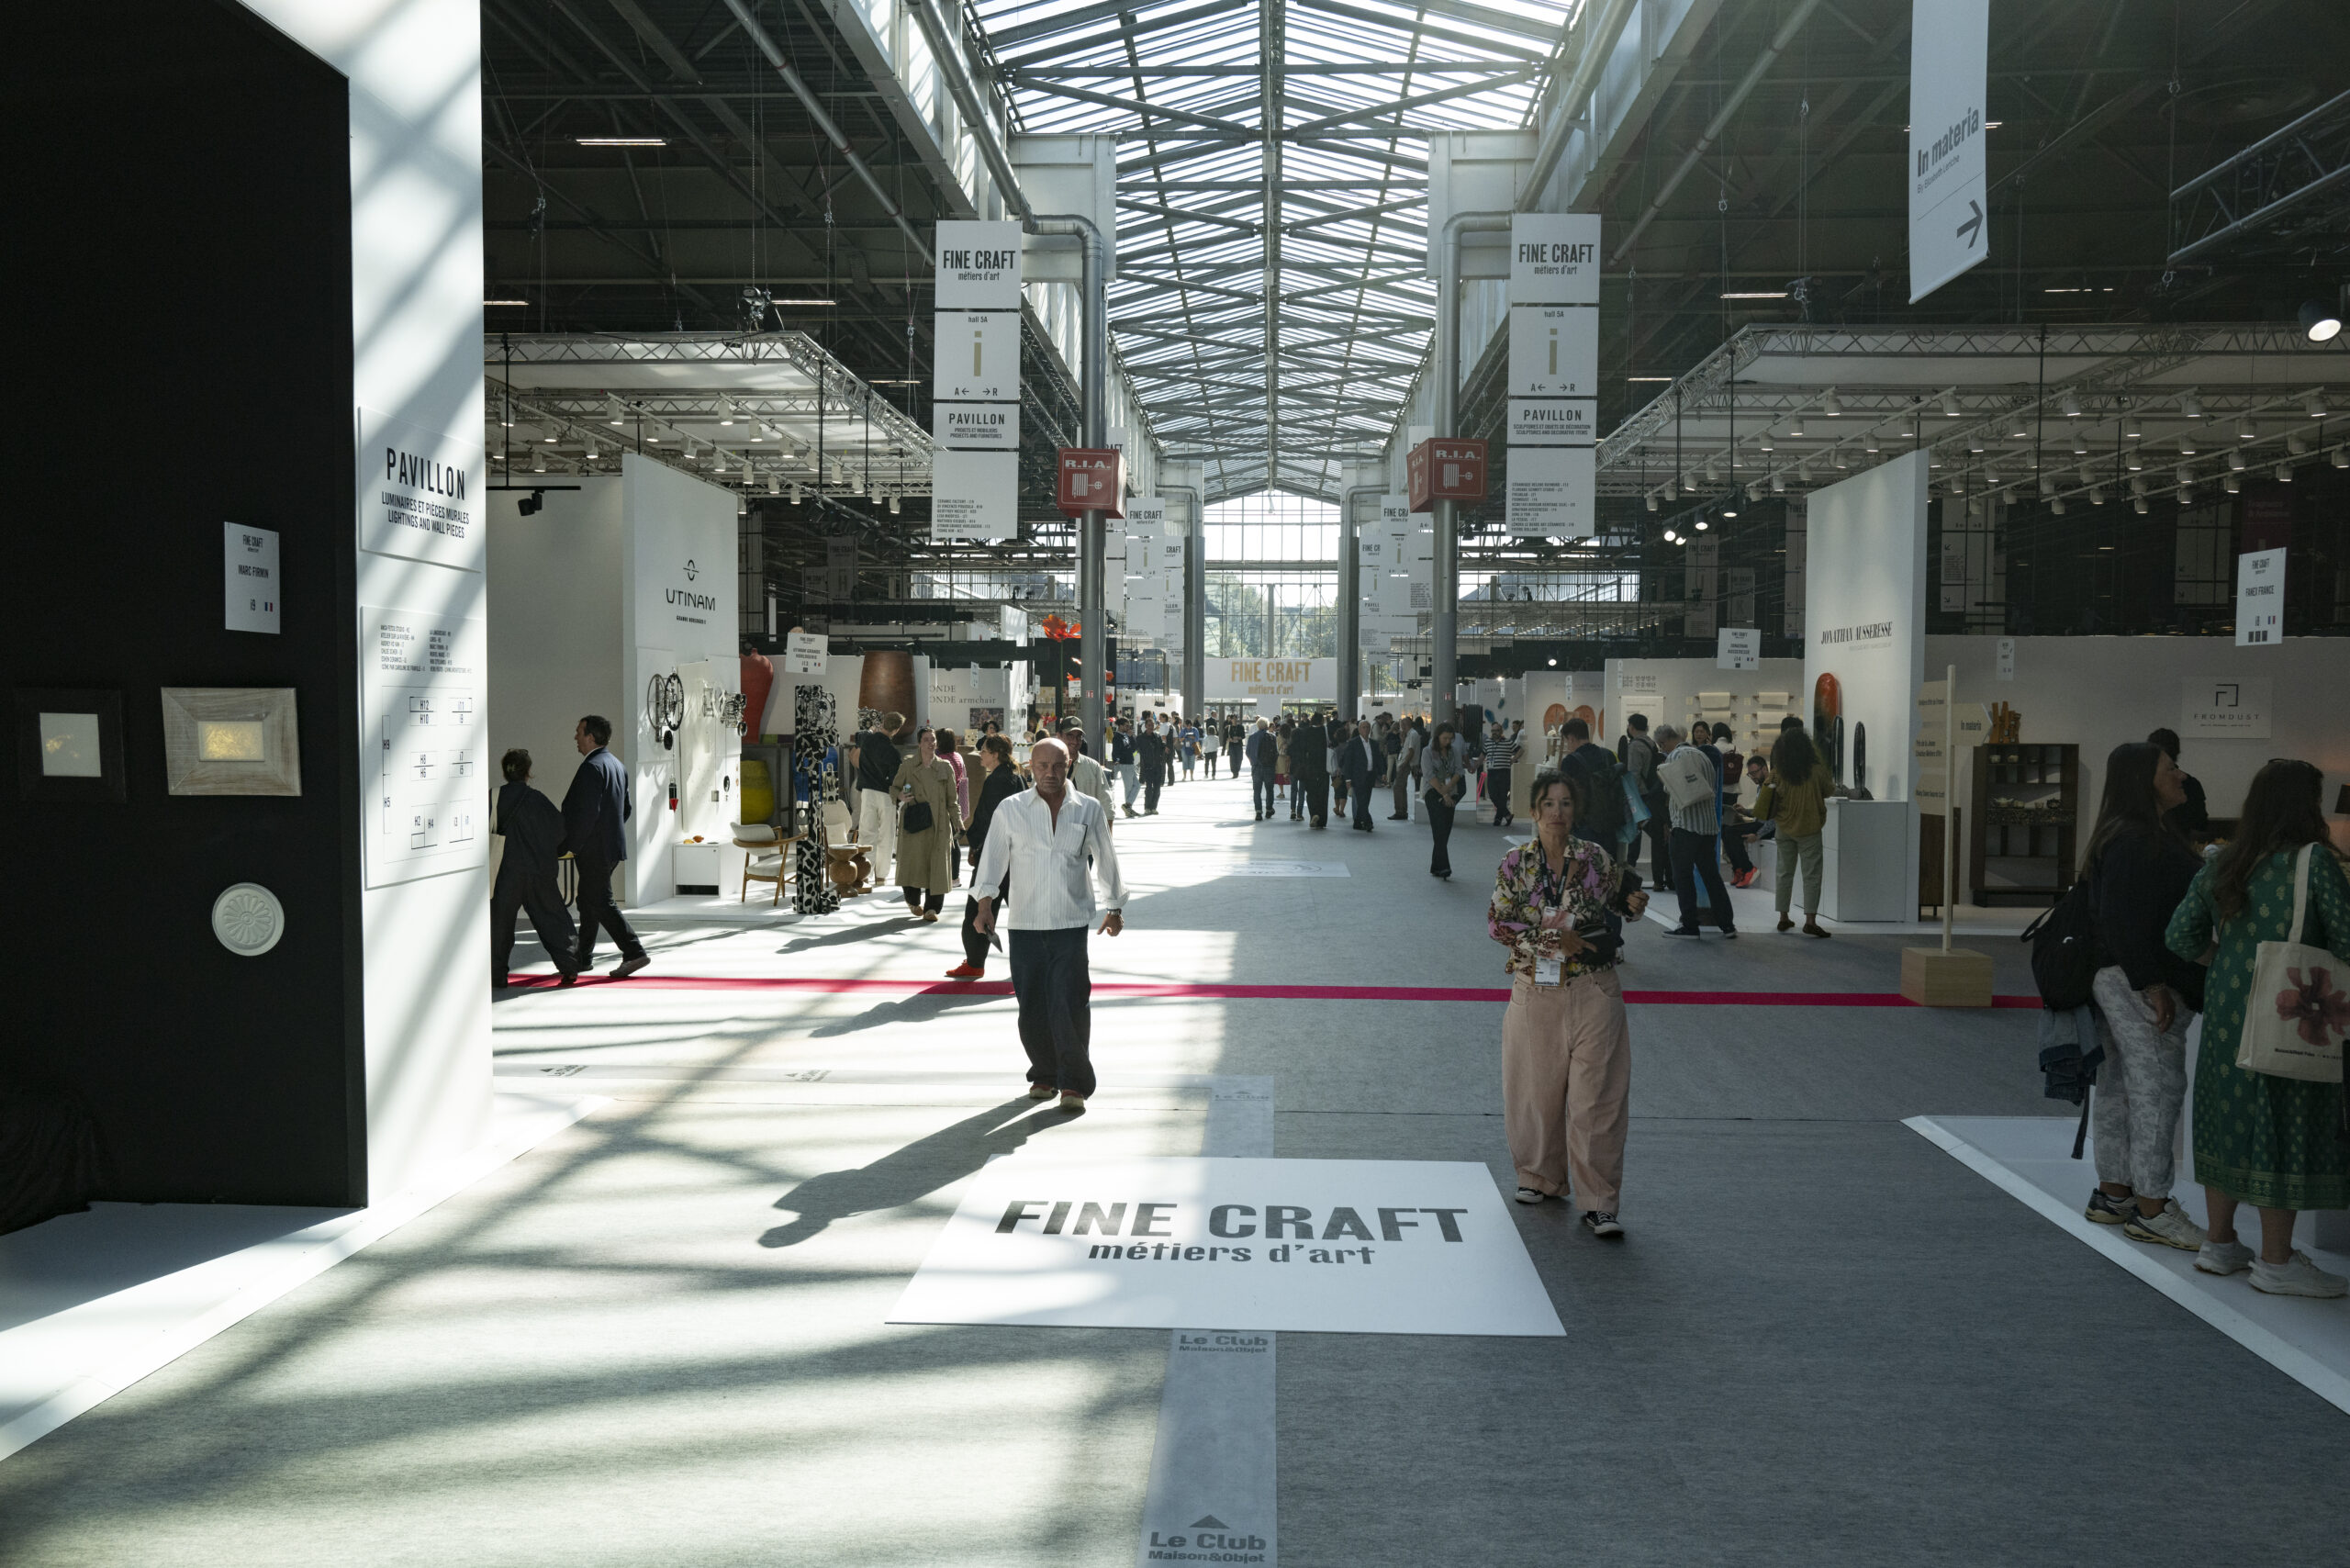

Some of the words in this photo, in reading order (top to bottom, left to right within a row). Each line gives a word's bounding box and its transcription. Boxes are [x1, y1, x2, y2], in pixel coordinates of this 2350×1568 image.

[1918, 148, 1930, 177] In
[1931, 106, 1979, 166] materia
[1917, 183, 1924, 195] By
[1519, 243, 1547, 263] FINE
[1551, 243, 1594, 263] CRAFT
[943, 250, 970, 269] FINE
[975, 250, 1015, 270] CRAFT
[1534, 265, 1560, 275] métiers
[1561, 264, 1577, 275] d'art
[957, 271, 982, 281] métiers
[984, 272, 1000, 281] d'art
[973, 330, 982, 376] i
[1549, 328, 1558, 375] i
[955, 387, 959, 396] A
[992, 387, 998, 396] R
[1530, 383, 1536, 392] A
[1570, 383, 1575, 392] R
[949, 412, 1005, 425] PAVILLON
[1524, 409, 1582, 421] PAVILLON
[1436, 450, 1481, 459] R.I.A.
[1065, 459, 1112, 469] R.I.A.
[386, 447, 465, 501] PAVILLON
[382, 491, 417, 513] LUMINAIRES
[418, 500, 424, 513] ET
[426, 501, 445, 520] PIÈCES
[446, 508, 469, 524] MURALES
[1383, 508, 1396, 517] FINE
[1130, 511, 1142, 520] FINE
[1144, 511, 1162, 520] CRAFT
[388, 510, 418, 528] LIGHTINGS
[419, 517, 430, 531] AND
[431, 520, 445, 534] WALL
[446, 523, 464, 538] PIECES
[243, 534, 252, 546] FINE
[252, 536, 263, 548] CRAFT
[2259, 558, 2270, 568] CRAFT
[238, 565, 252, 577] MARC
[252, 566, 269, 578] FIRMIN
[2258, 585, 2275, 596] FRANCE
[666, 588, 716, 611] UTINAM
[1821, 627, 1852, 644] JONATHAN
[1854, 622, 1893, 641] AUSSERESSE
[1231, 662, 1261, 682] FINE
[1266, 662, 1312, 683] CRAFT
[1248, 685, 1274, 695] métiers
[420, 700, 429, 710] H12
[958, 696, 996, 704] armchair
[420, 714, 429, 724] H10
[415, 815, 421, 826] H2
[995, 1201, 1177, 1237] FINE
[1209, 1204, 1468, 1242] CRAFT
[1089, 1241, 1251, 1261] métiers
[1270, 1244, 1375, 1264] d'art
[1180, 1335, 1208, 1345] Le
[1215, 1336, 1269, 1346] Club
[1179, 1346, 1267, 1354] Maison&Objet
[1150, 1532, 1186, 1548] Le
[1197, 1533, 1267, 1551] Club
[1148, 1551, 1266, 1564] Maison&Objet
